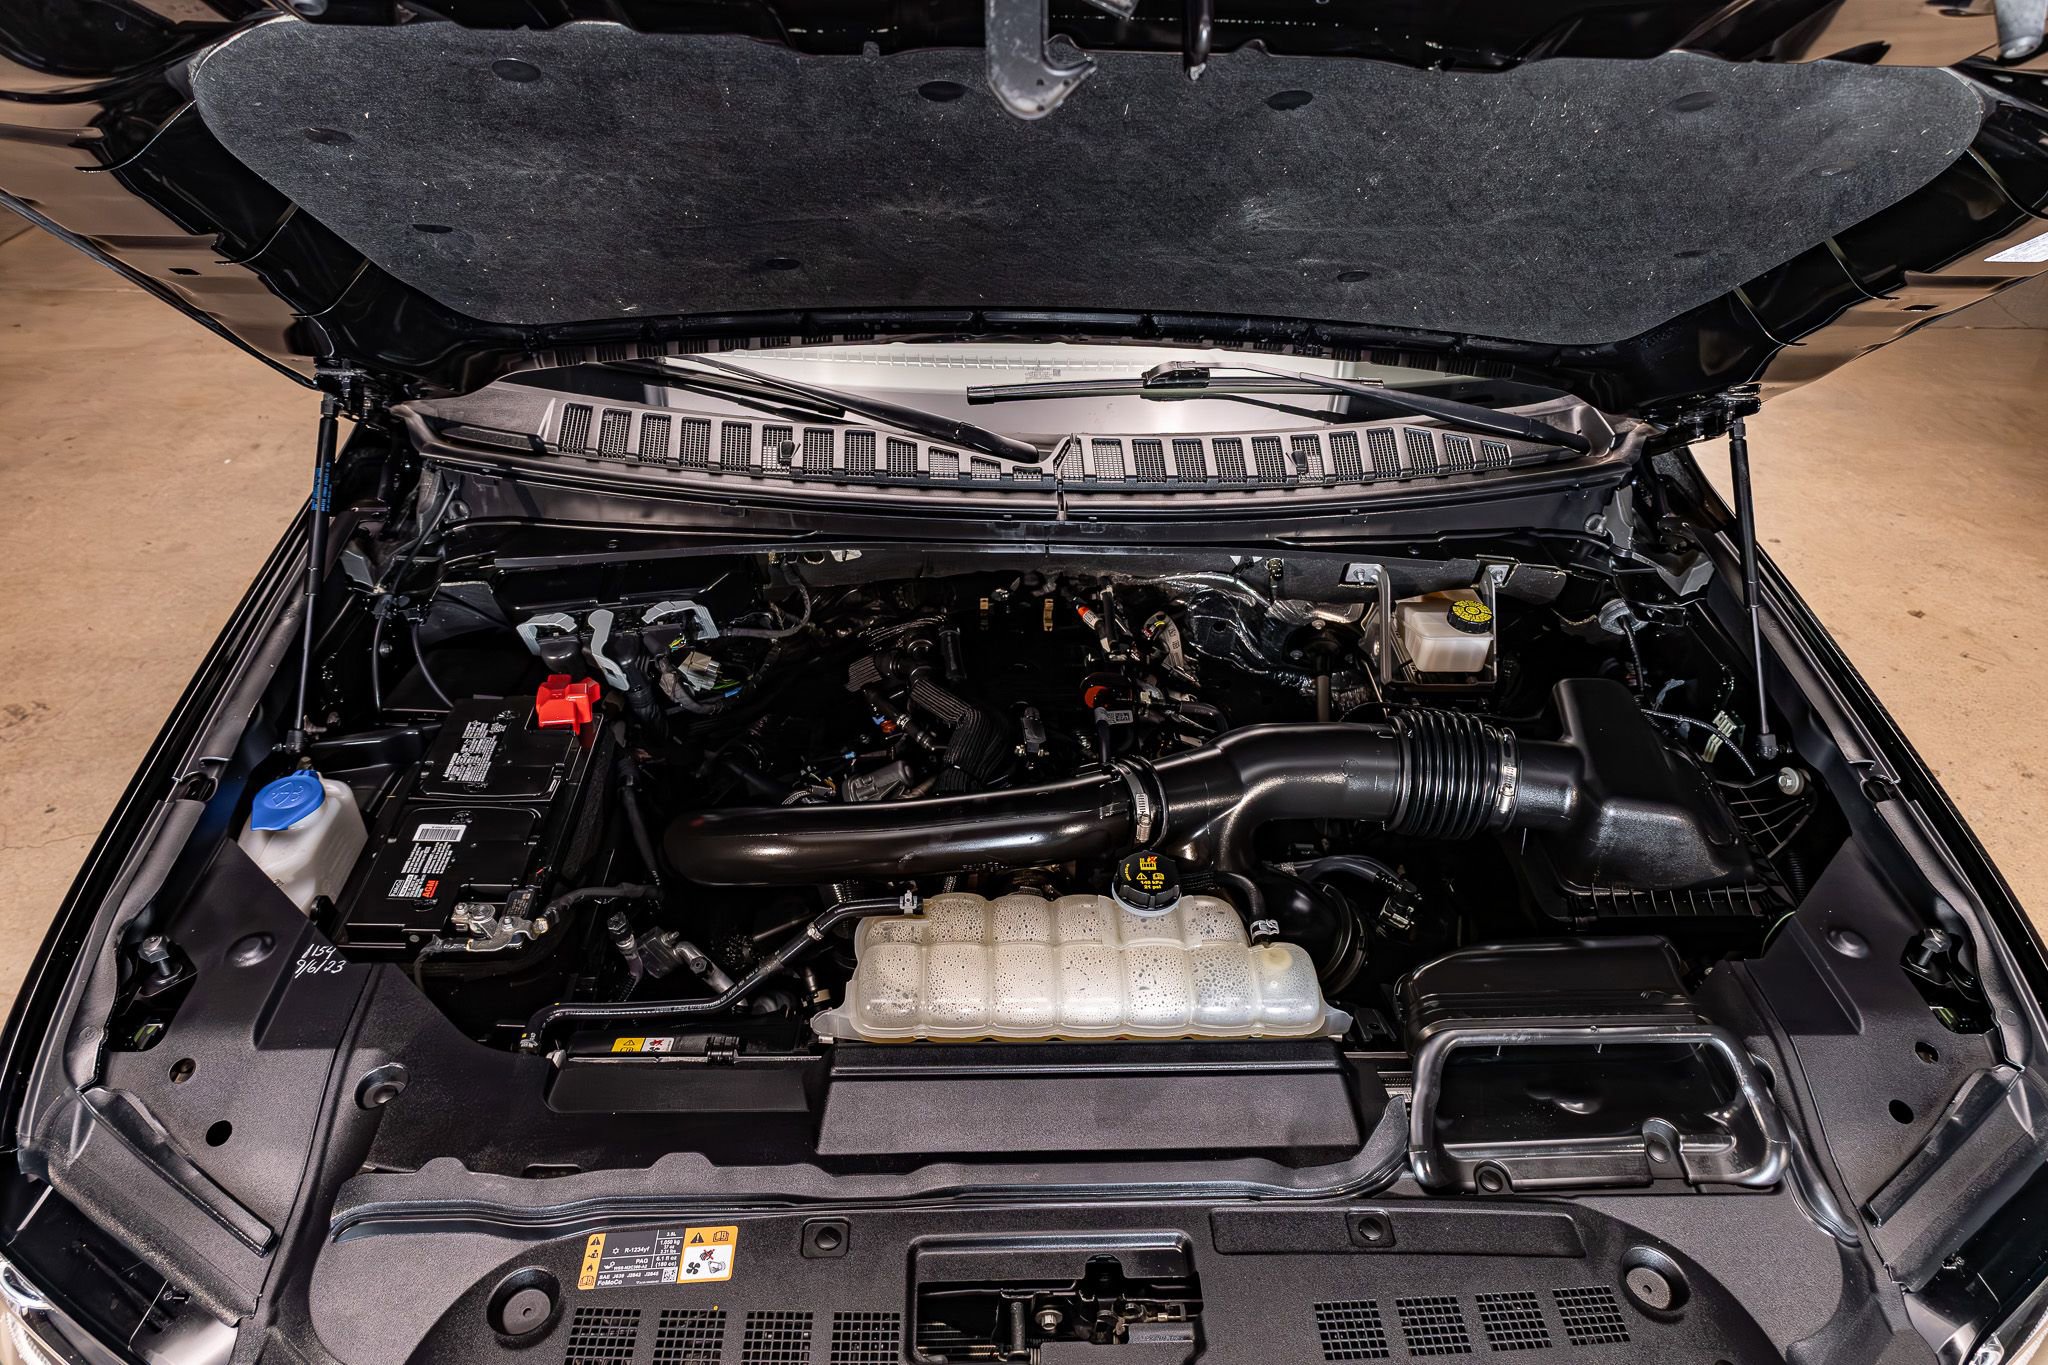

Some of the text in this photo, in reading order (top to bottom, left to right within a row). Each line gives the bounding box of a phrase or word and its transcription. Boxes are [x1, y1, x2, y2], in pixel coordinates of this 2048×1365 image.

[422, 880, 436, 898] AGM
[294, 959, 347, 979] 9/6/23
[624, 1246, 651, 1254] R-1234yf
